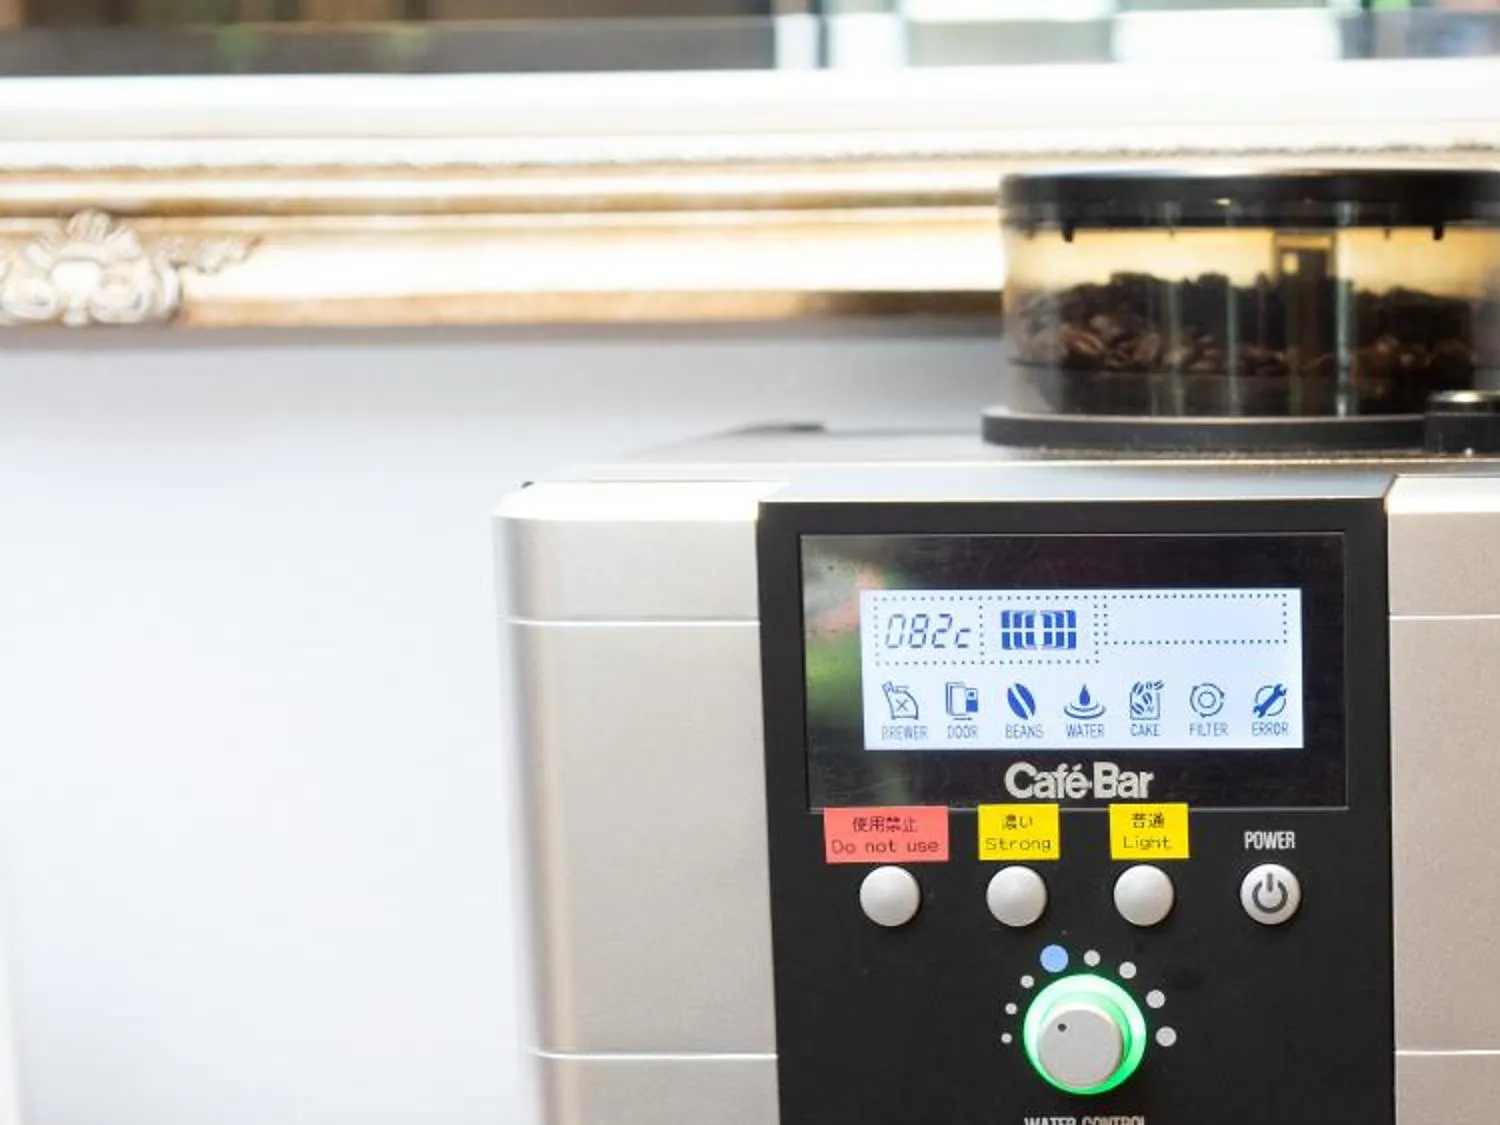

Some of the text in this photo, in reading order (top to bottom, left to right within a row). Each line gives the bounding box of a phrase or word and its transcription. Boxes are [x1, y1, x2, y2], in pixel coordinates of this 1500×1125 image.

[881, 725, 928, 741] BREWER
[947, 725, 979, 740] DOOR
[1005, 724, 1044, 739] BEANS
[1066, 724, 1105, 739] WATER
[1130, 723, 1160, 738] CAKE
[1189, 723, 1229, 737] FILTER
[1251, 722, 1289, 737] ERROR
[851, 815, 918, 833] 使用禁止
[1001, 814, 1034, 831] 濃い
[1131, 811, 1166, 830] 普通
[831, 839, 940, 855] Do not use
[985, 837, 1052, 853] Strong
[1122, 835, 1172, 851] Light
[1244, 831, 1296, 850] POWER
